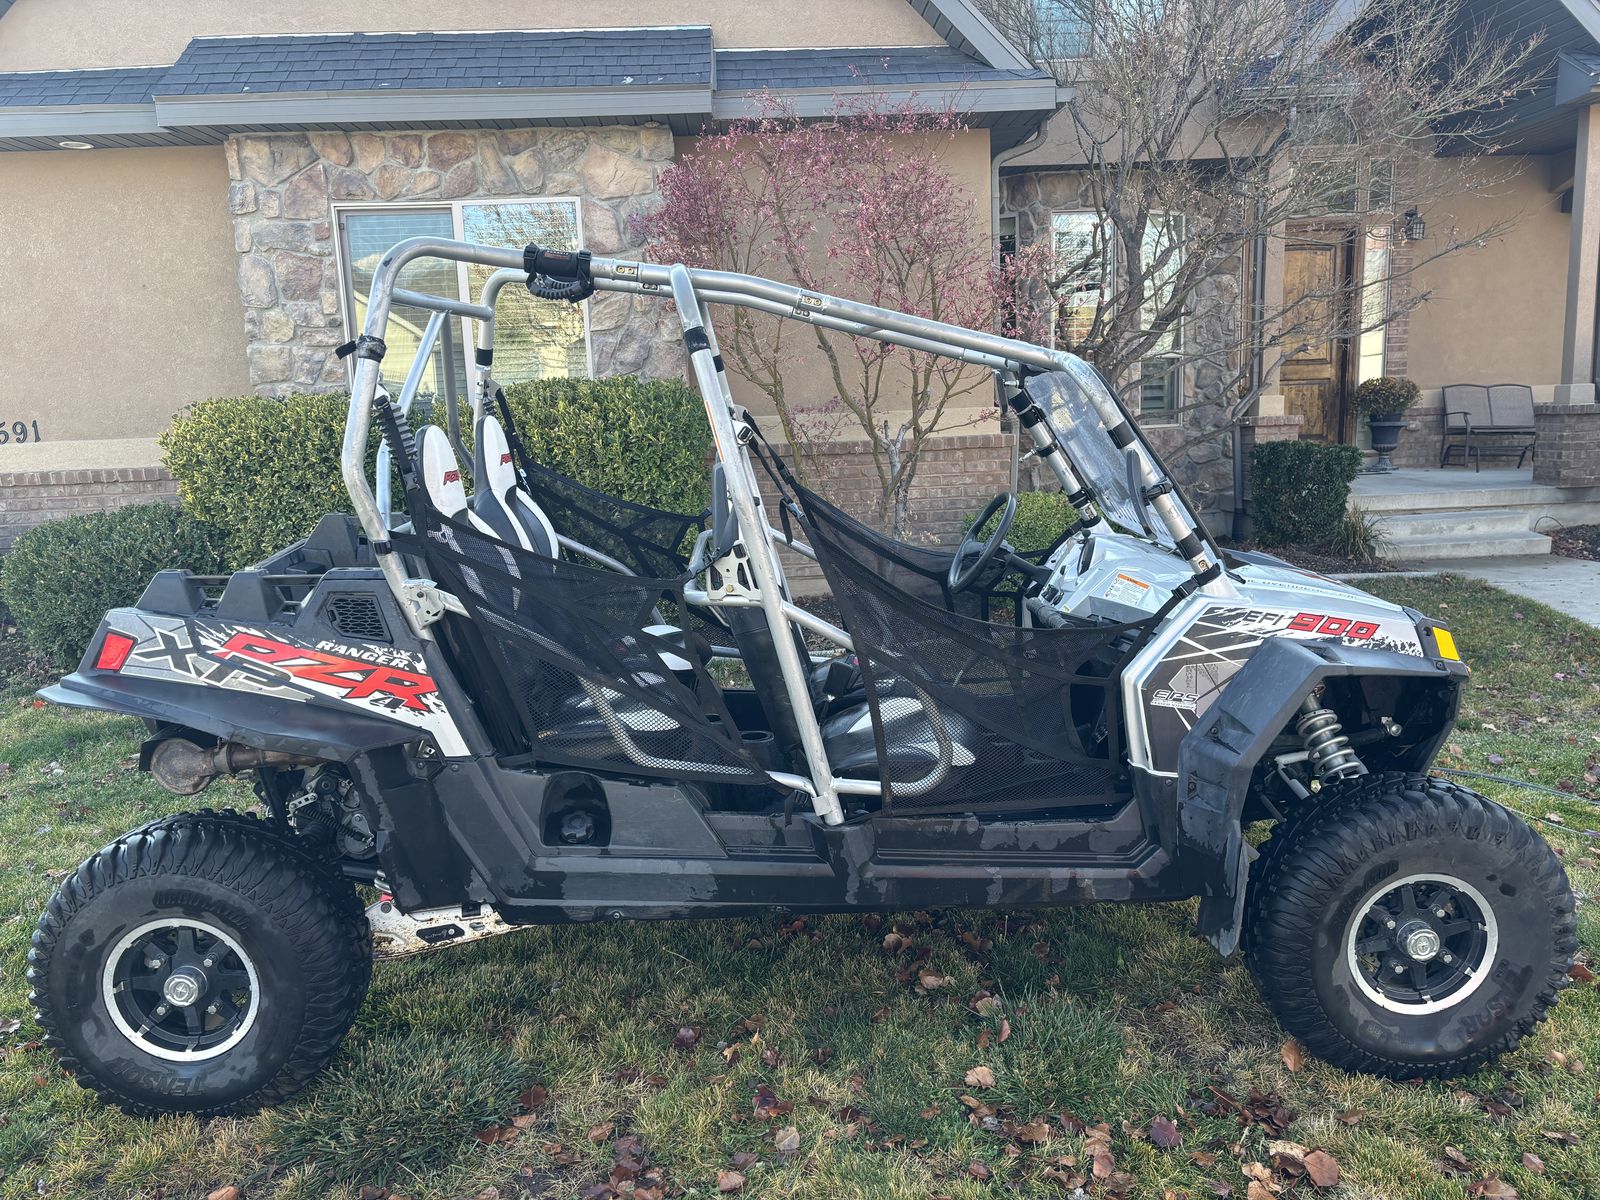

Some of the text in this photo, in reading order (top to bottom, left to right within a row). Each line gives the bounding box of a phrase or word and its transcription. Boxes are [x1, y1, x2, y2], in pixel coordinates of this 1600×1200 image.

[0, 420, 41, 445] 591
[1242, 610, 1381, 640] EFI 900
[132, 626, 438, 712] XP RZR
[315, 640, 409, 670] RANGER
[1153, 688, 1199, 703] EPS
